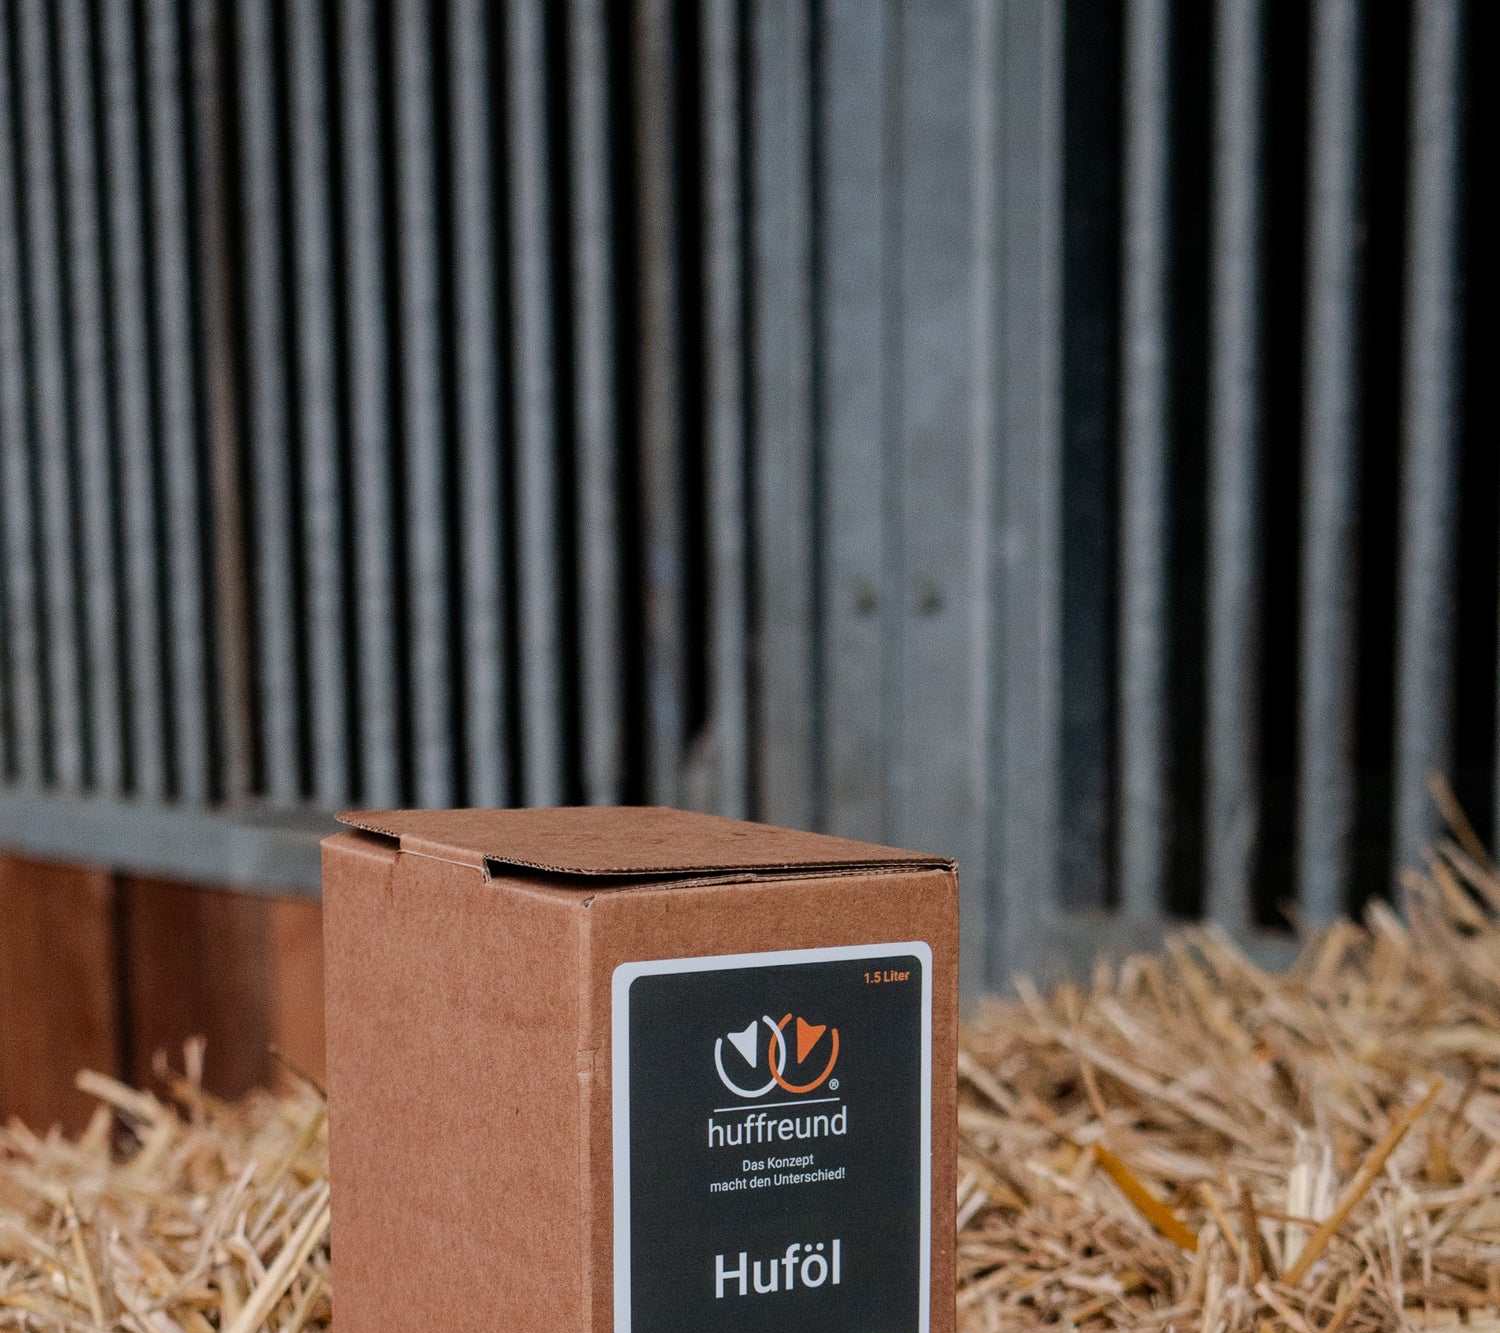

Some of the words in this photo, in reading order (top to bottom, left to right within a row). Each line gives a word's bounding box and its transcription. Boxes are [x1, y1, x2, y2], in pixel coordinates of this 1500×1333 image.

[863, 971, 881, 984] 1.5
[883, 970, 911, 983] Liter
[708, 1105, 848, 1148] huffreund
[742, 1159, 765, 1172] Das
[767, 1153, 814, 1170] Konzept
[710, 1177, 747, 1193] macht
[749, 1174, 771, 1188] den
[773, 1167, 846, 1186] Unterschied!
[715, 1238, 841, 1299] Huföl
